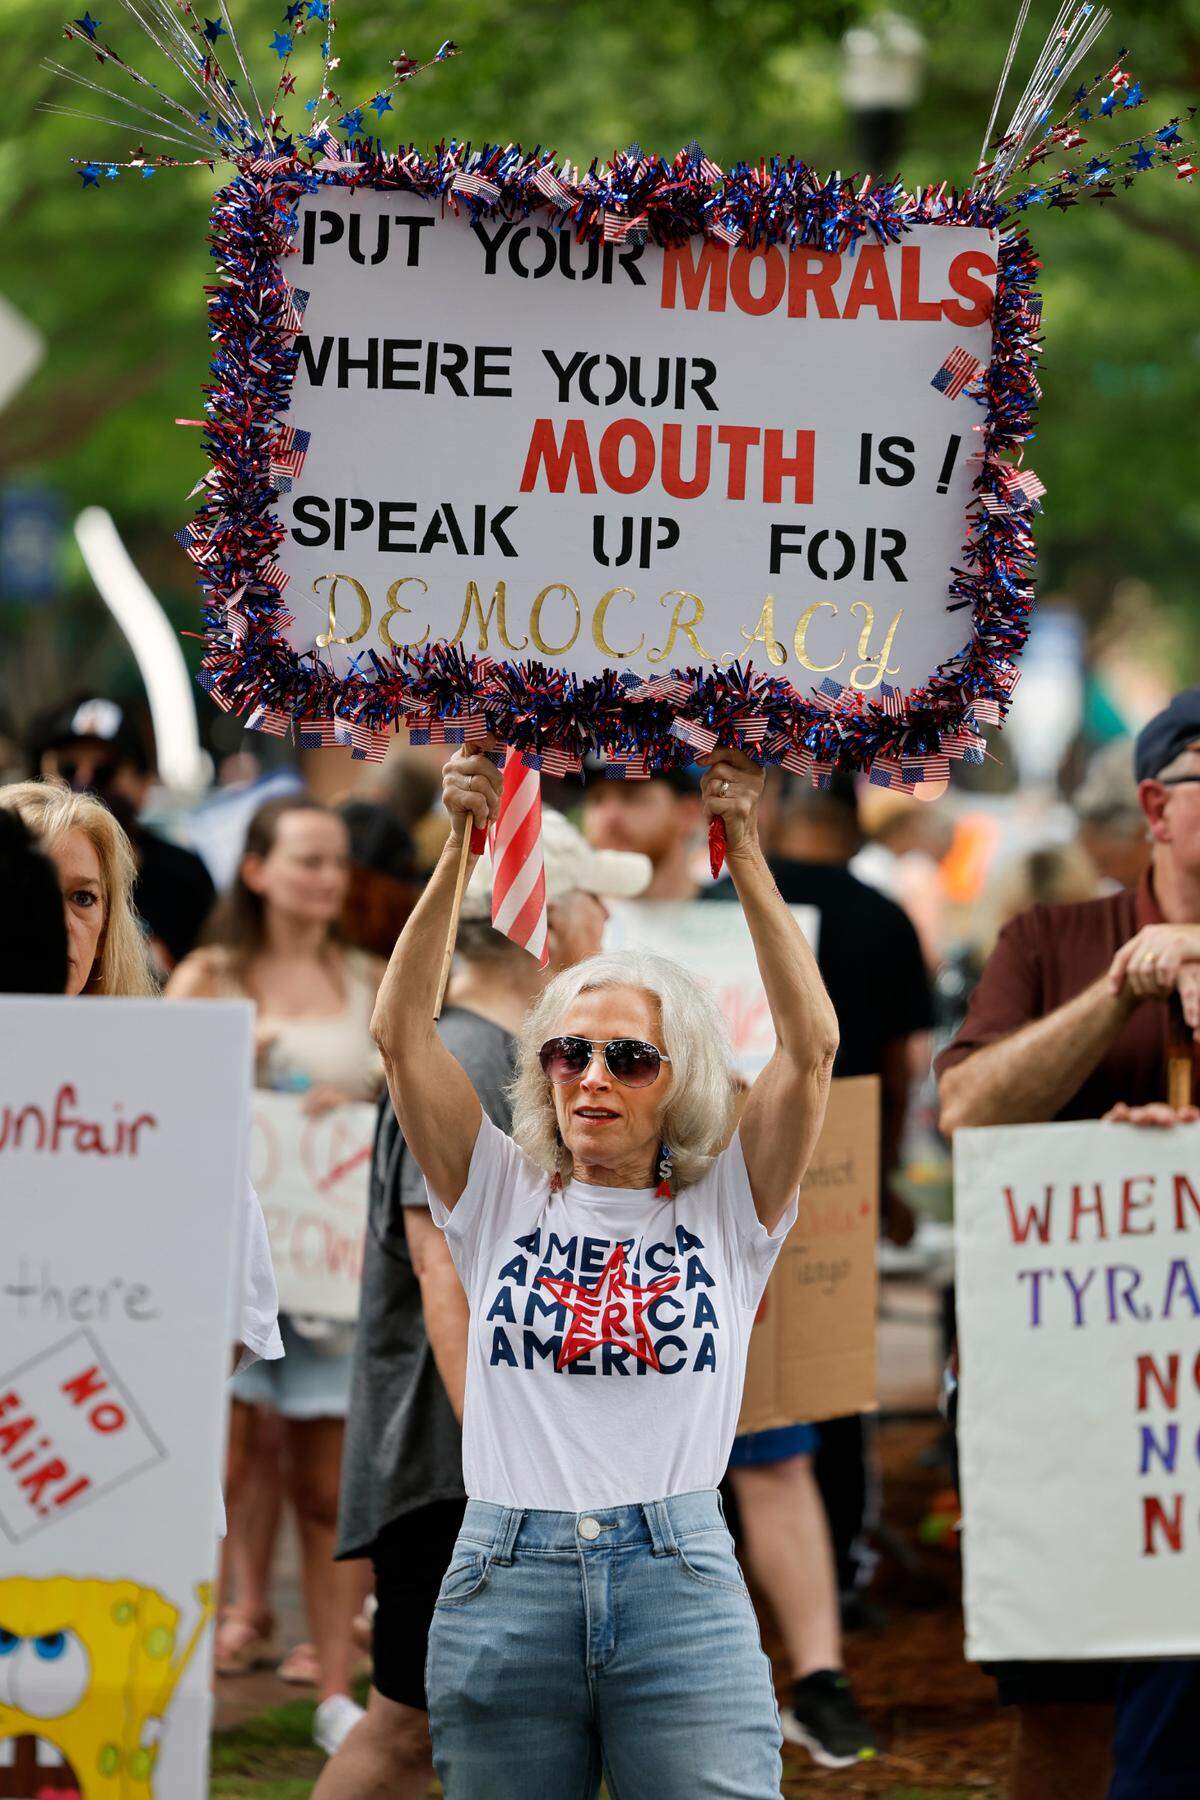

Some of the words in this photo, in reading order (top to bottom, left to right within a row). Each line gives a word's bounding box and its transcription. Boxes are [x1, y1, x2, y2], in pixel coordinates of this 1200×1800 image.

[302, 210, 435, 267] PUT
[470, 221, 647, 286] YOUR
[660, 239, 998, 328] MORALS
[292, 335, 513, 398] WHERE
[541, 349, 719, 411] YOUR
[519, 418, 816, 505] MOUTH
[858, 433, 916, 487] IS
[290, 496, 519, 557] SPEAK
[593, 515, 680, 569] UP
[769, 524, 909, 582] FOR
[311, 574, 905, 690] DEMOCRACY
[513, 1224, 705, 1274] AMERICA
[4, 1254, 162, 1322] there
[486, 1286, 720, 1340] AMERICA
[490, 1326, 717, 1376] AMERICA
[61, 1365, 126, 1434] NO
